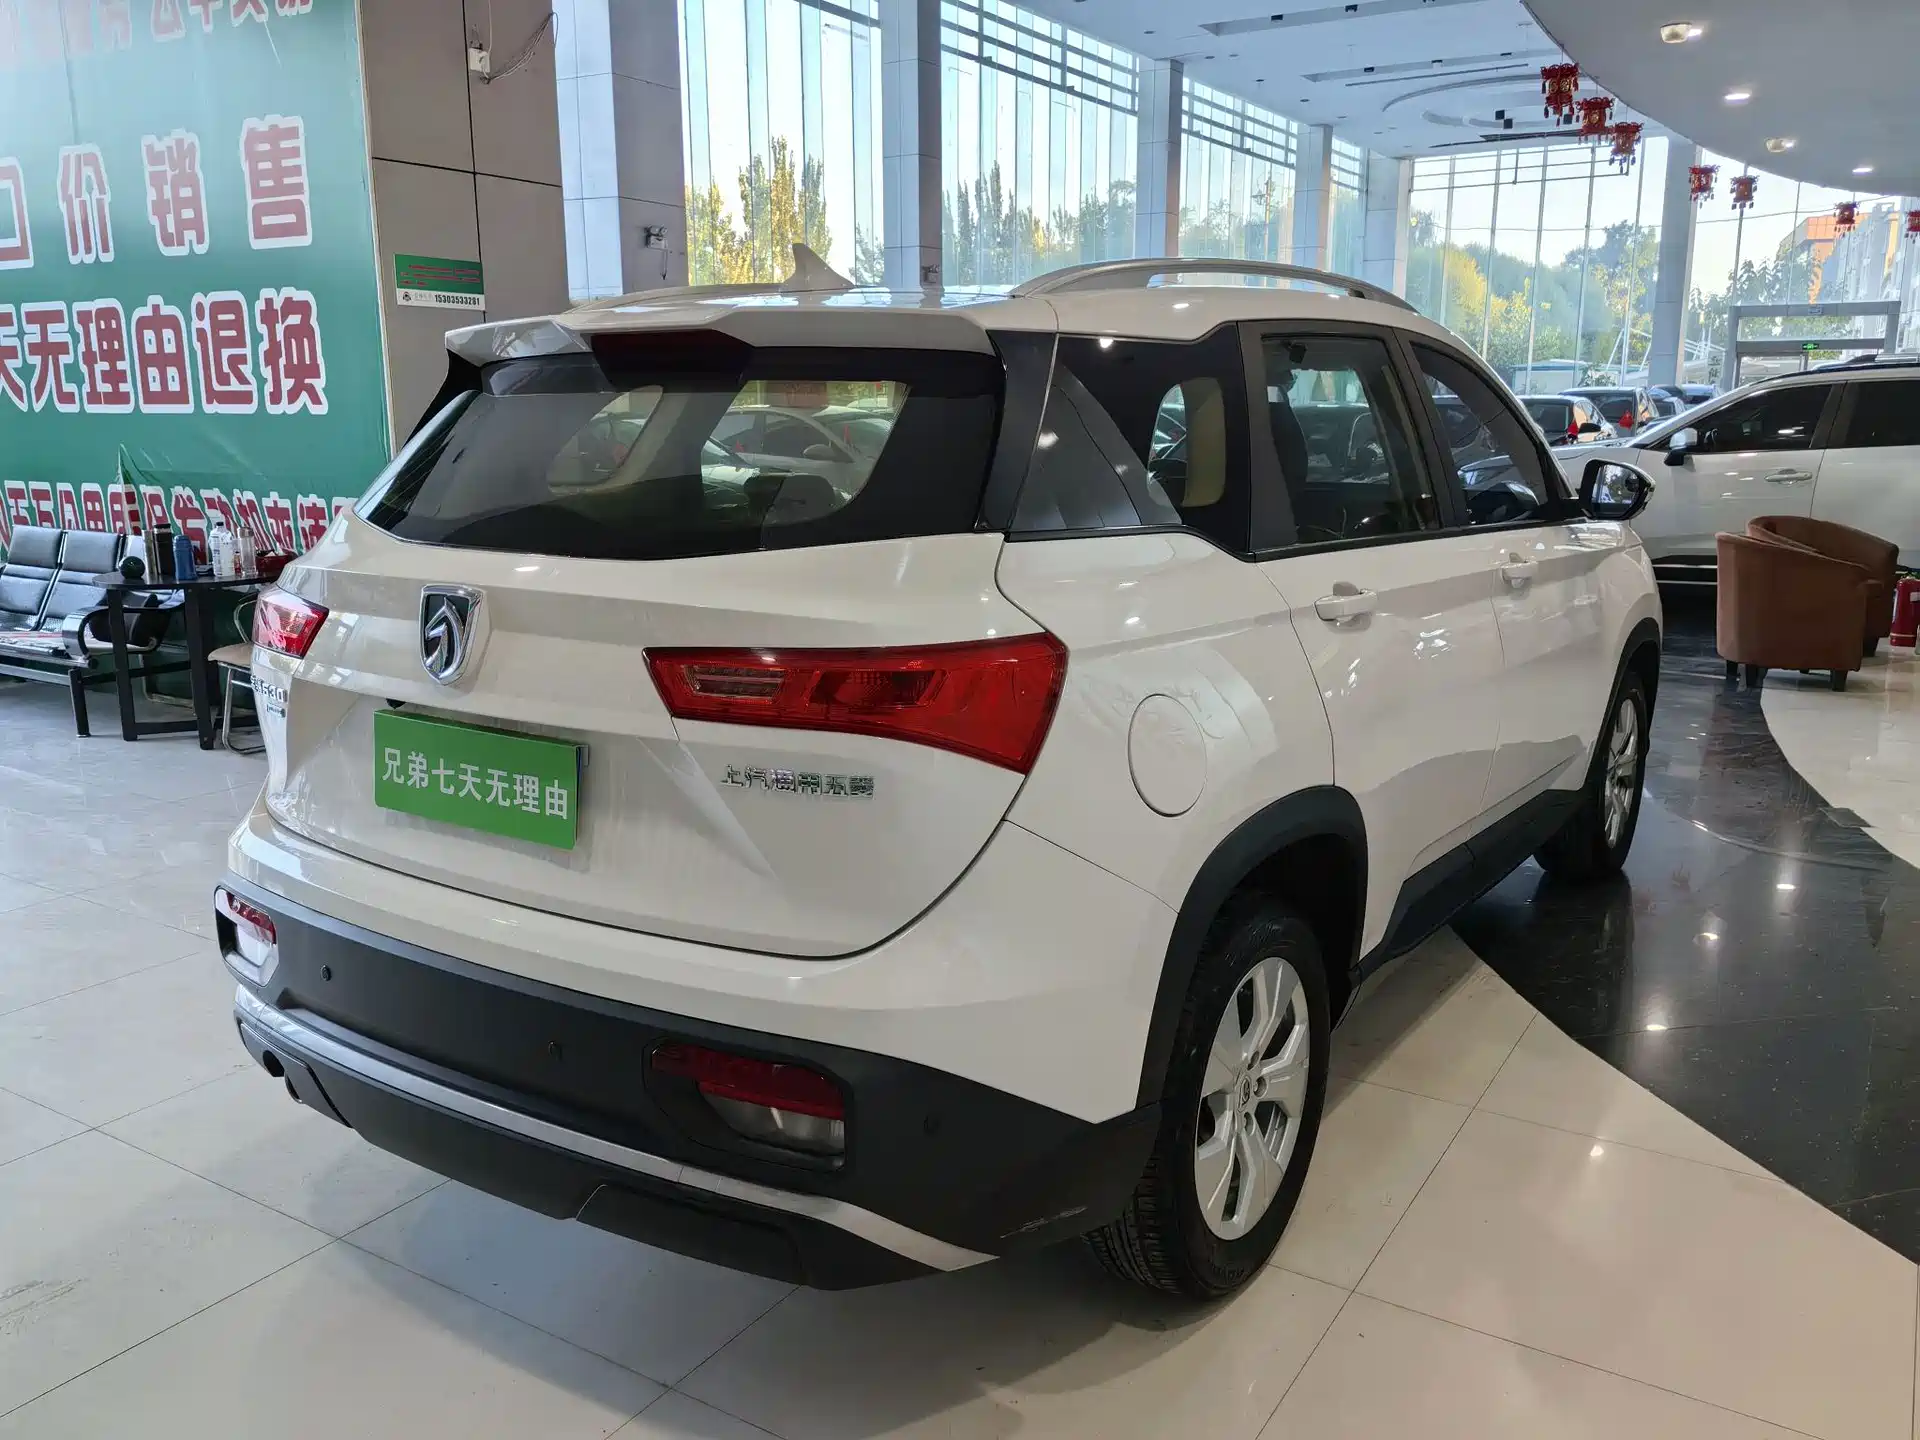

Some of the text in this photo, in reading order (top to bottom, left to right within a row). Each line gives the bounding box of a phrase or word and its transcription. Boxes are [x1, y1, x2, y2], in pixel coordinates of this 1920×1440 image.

[434, 294, 480, 306] 15303533281
[382, 747, 569, 820] 兄弟七天无理由
[720, 764, 876, 800] 上汽通用五菱
